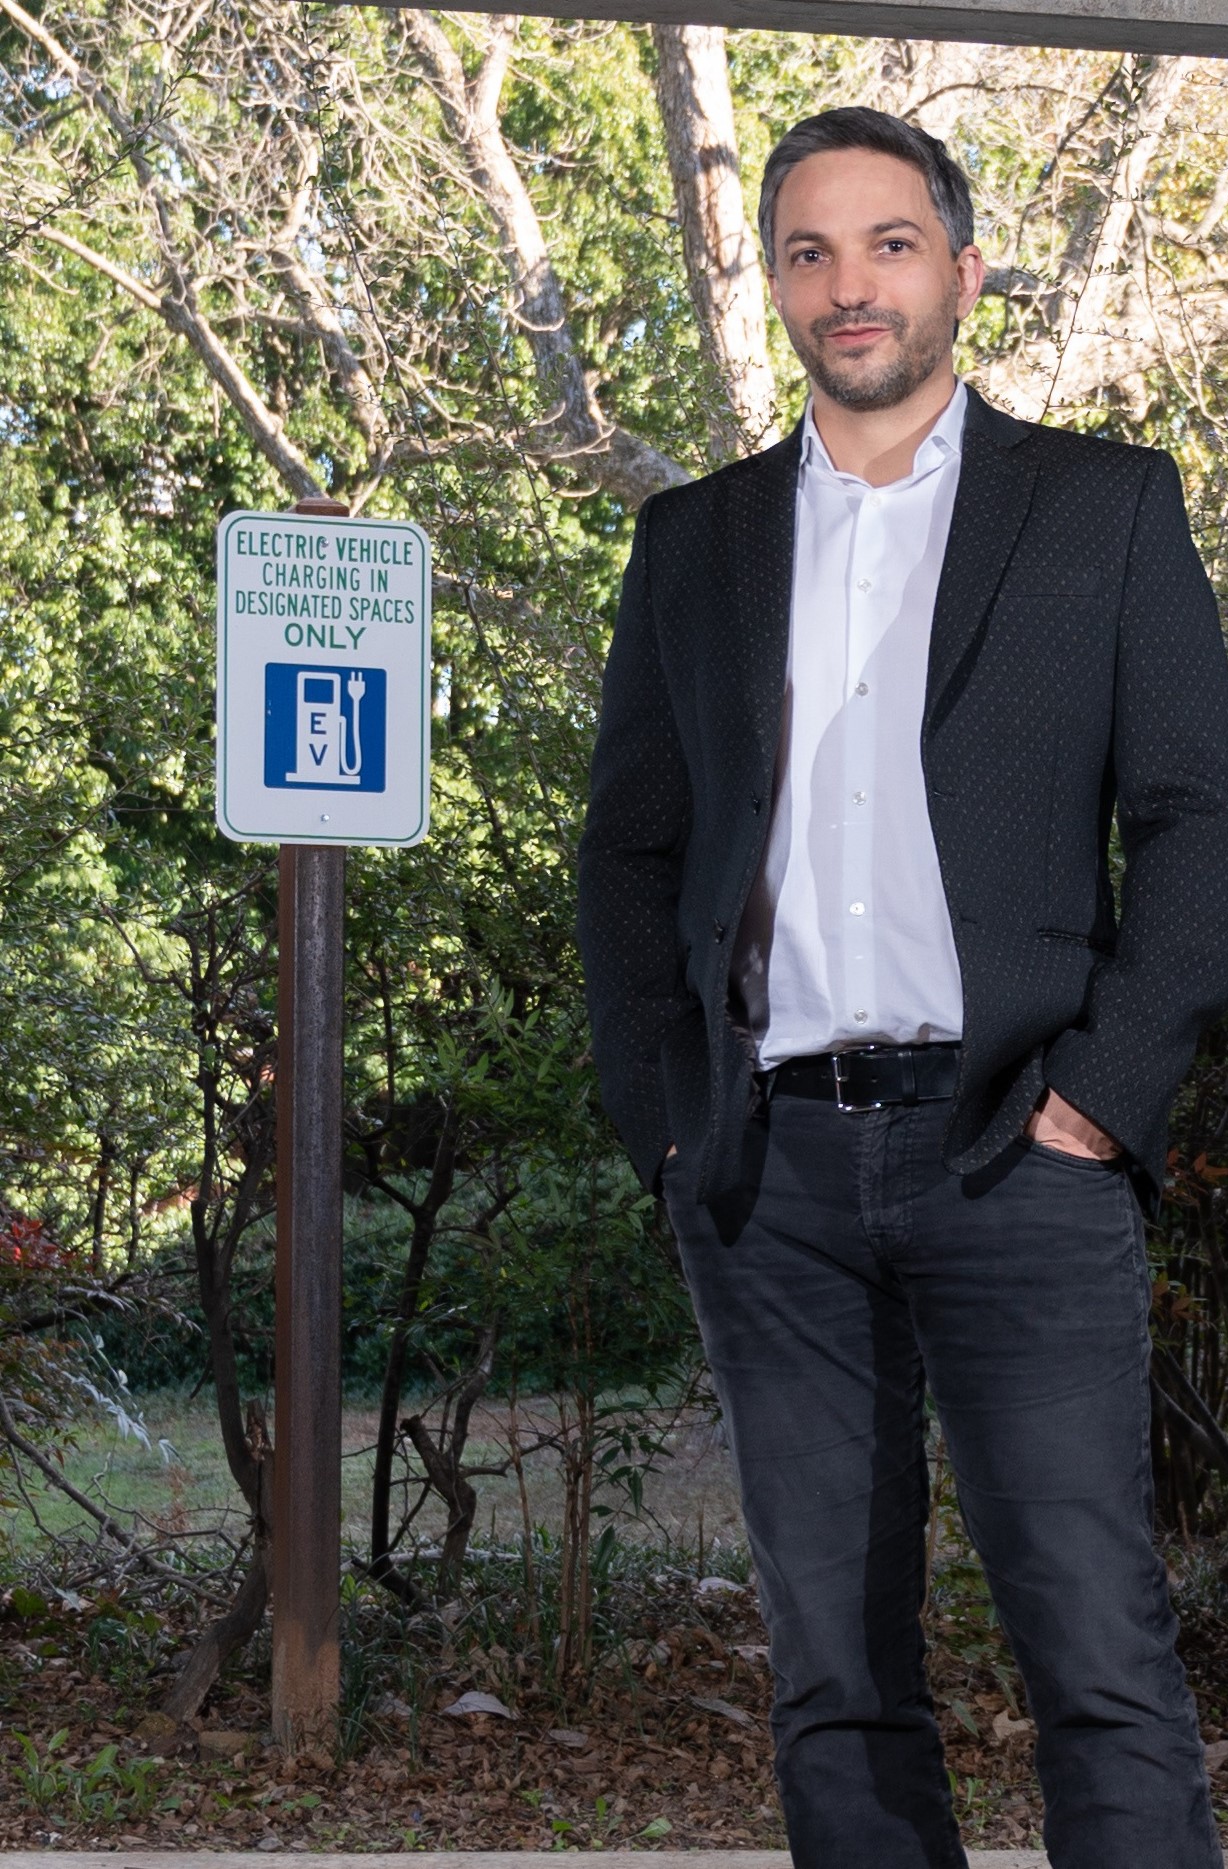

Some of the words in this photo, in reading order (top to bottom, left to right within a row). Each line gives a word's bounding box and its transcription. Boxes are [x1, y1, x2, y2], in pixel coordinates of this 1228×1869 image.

[237, 531, 328, 561] ELECTRIC
[336, 537, 414, 566] VEHICLE
[262, 562, 361, 592] CHARGING
[370, 568, 389, 593] IN
[235, 591, 342, 620] DESIGNATED
[349, 597, 415, 624] SPACES
[284, 623, 367, 650] ONLY
